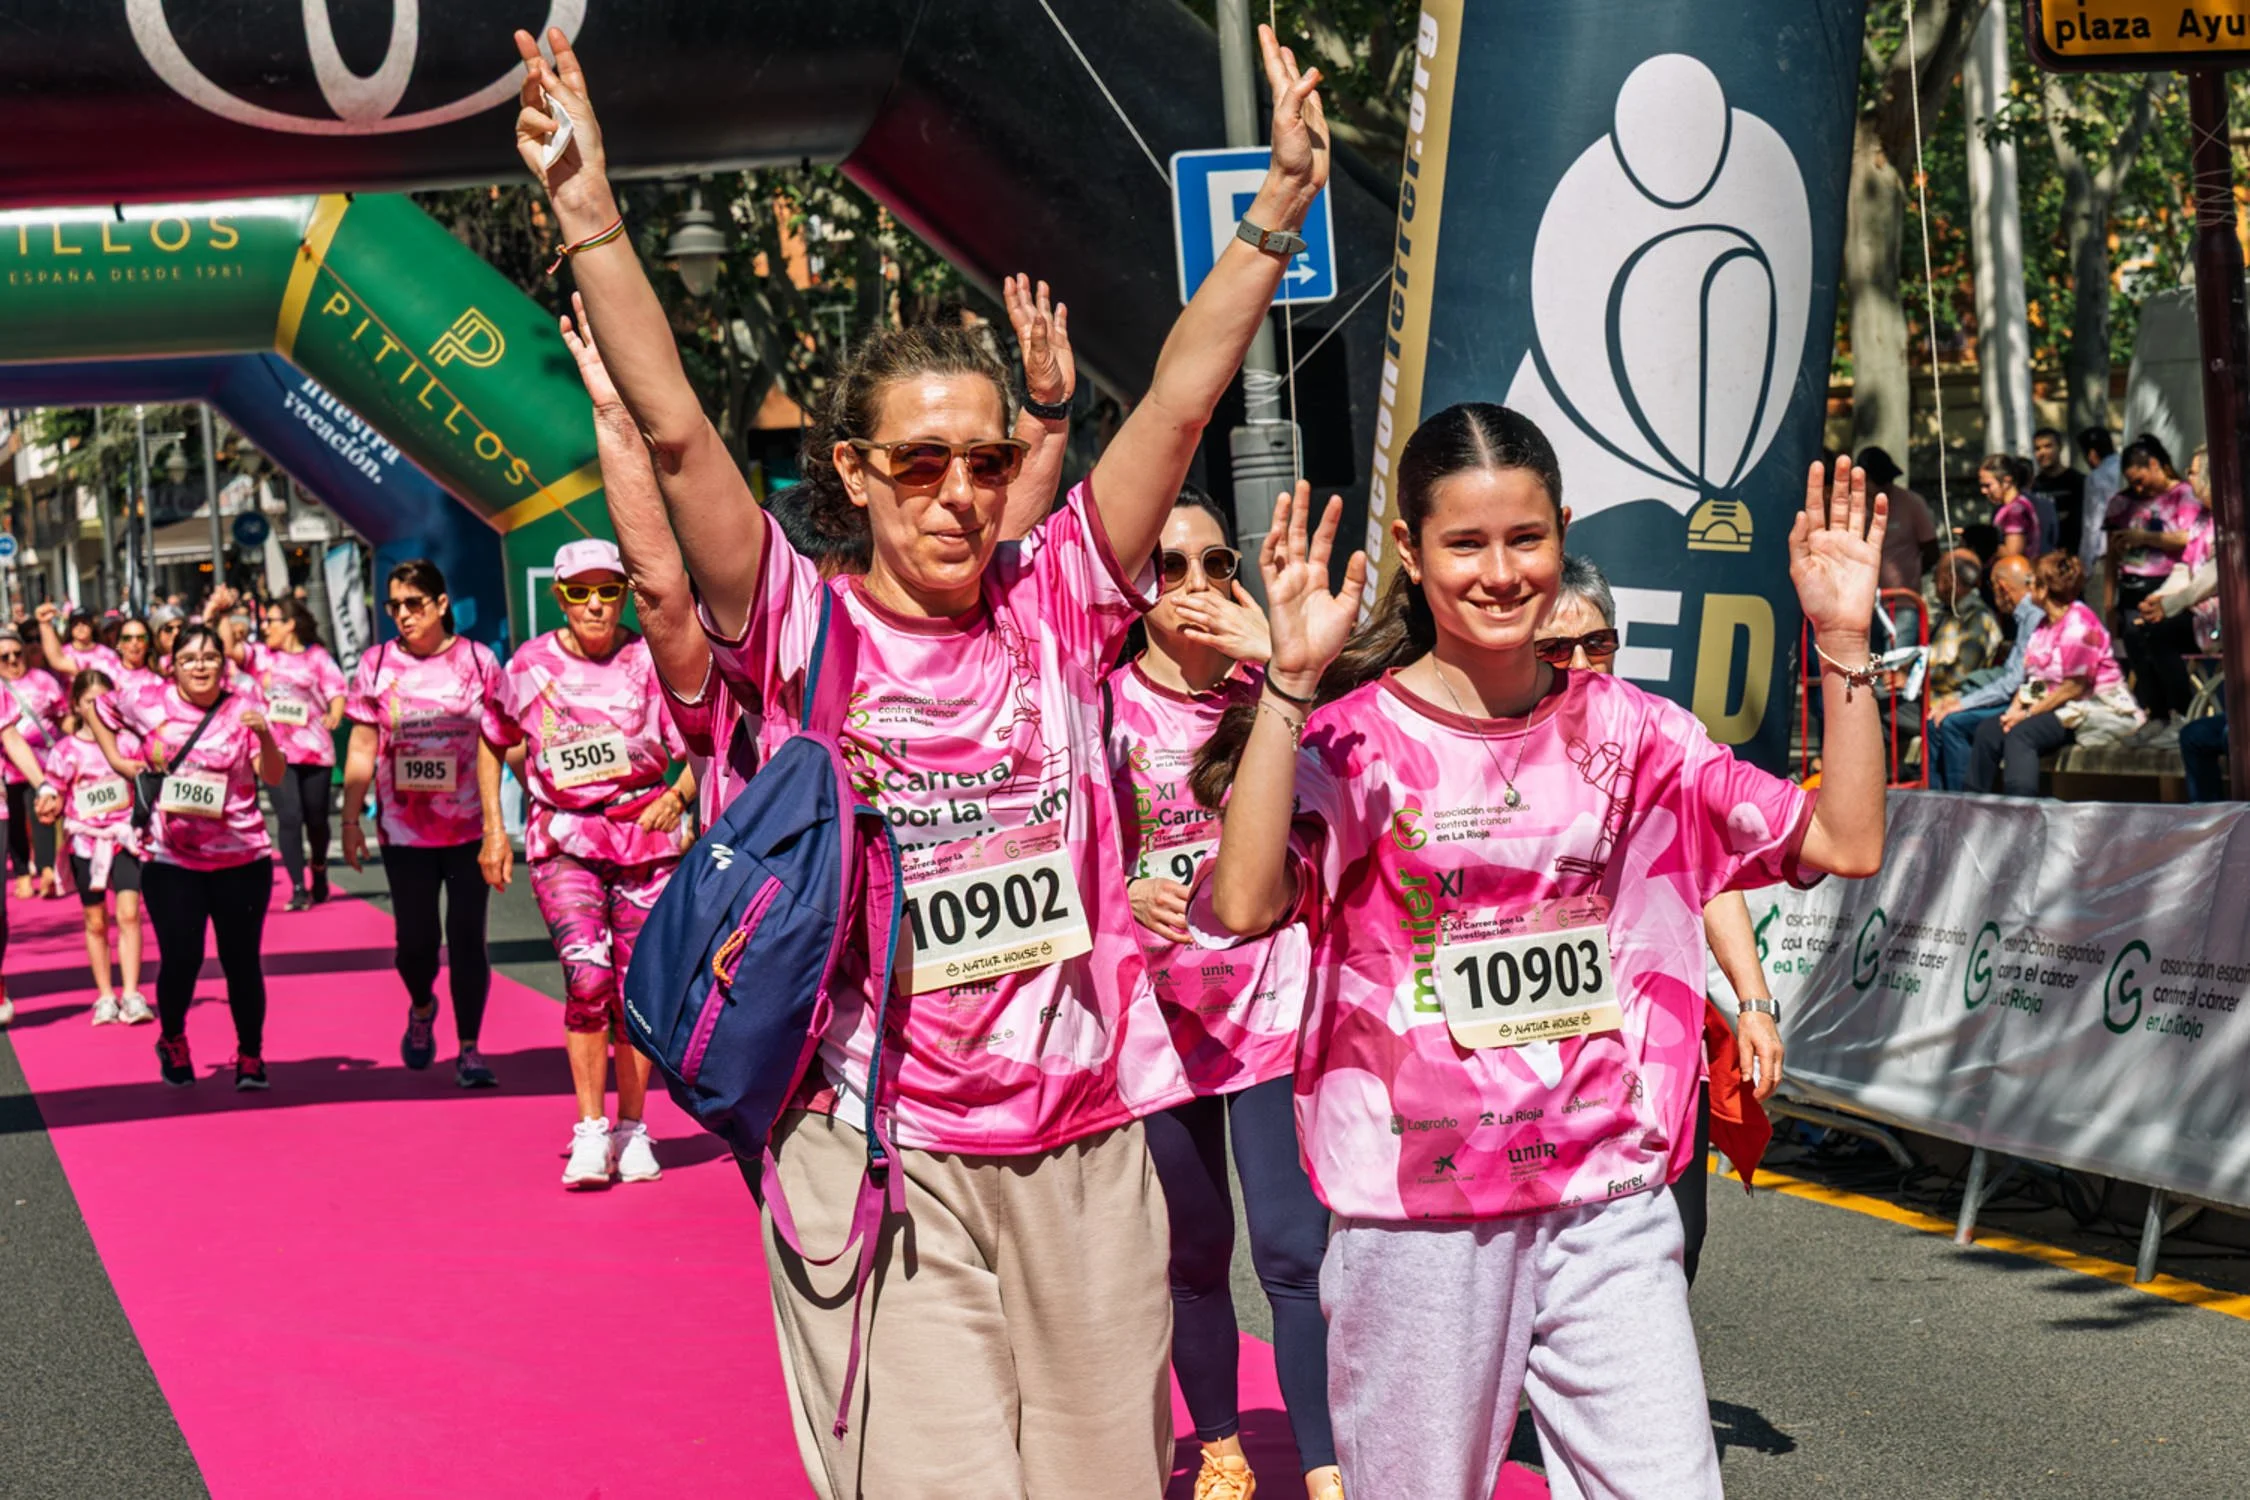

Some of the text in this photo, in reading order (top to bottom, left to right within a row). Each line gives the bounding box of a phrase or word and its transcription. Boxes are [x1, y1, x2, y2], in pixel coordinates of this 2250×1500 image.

[2056, 8, 2250, 49] plaza Ayu
[9, 264, 243, 287] ESPAÑA DESDE 1981
[322, 290, 529, 486] PITILLOS
[300, 377, 402, 466] nuestra
[283, 390, 383, 485] vocación.
[560, 742, 616, 772] 5505
[876, 736, 907, 758] XI
[404, 760, 447, 780] 1985
[883, 762, 1012, 793] Carrera
[87, 786, 117, 807] 908
[173, 781, 215, 806] 1986
[1155, 782, 1177, 802] XI
[887, 797, 983, 828] por la
[1433, 806, 1485, 819] asociación
[1434, 819, 1469, 831] contra
[1470, 819, 1479, 828] el
[1436, 829, 1491, 842] en La Rioja
[938, 856, 952, 868] por
[1434, 867, 1465, 898] XI
[908, 867, 1069, 952] 10902
[1464, 919, 1498, 930] Carrera
[1499, 917, 1515, 928] por
[962, 955, 1001, 973] NATUR
[1004, 946, 1038, 963] HOUSE
[1453, 939, 1603, 1009] 10903
[2024, 963, 2039, 982] el
[2040, 966, 2079, 989] cáncer
[2198, 987, 2240, 1013] cáncer
[1514, 1020, 1550, 1035] NATUR
[1552, 1016, 1580, 1030] HOUSE
[1407, 1107, 1544, 1132] Logroño La Rioja
[1607, 1174, 1644, 1197] Ferrer
